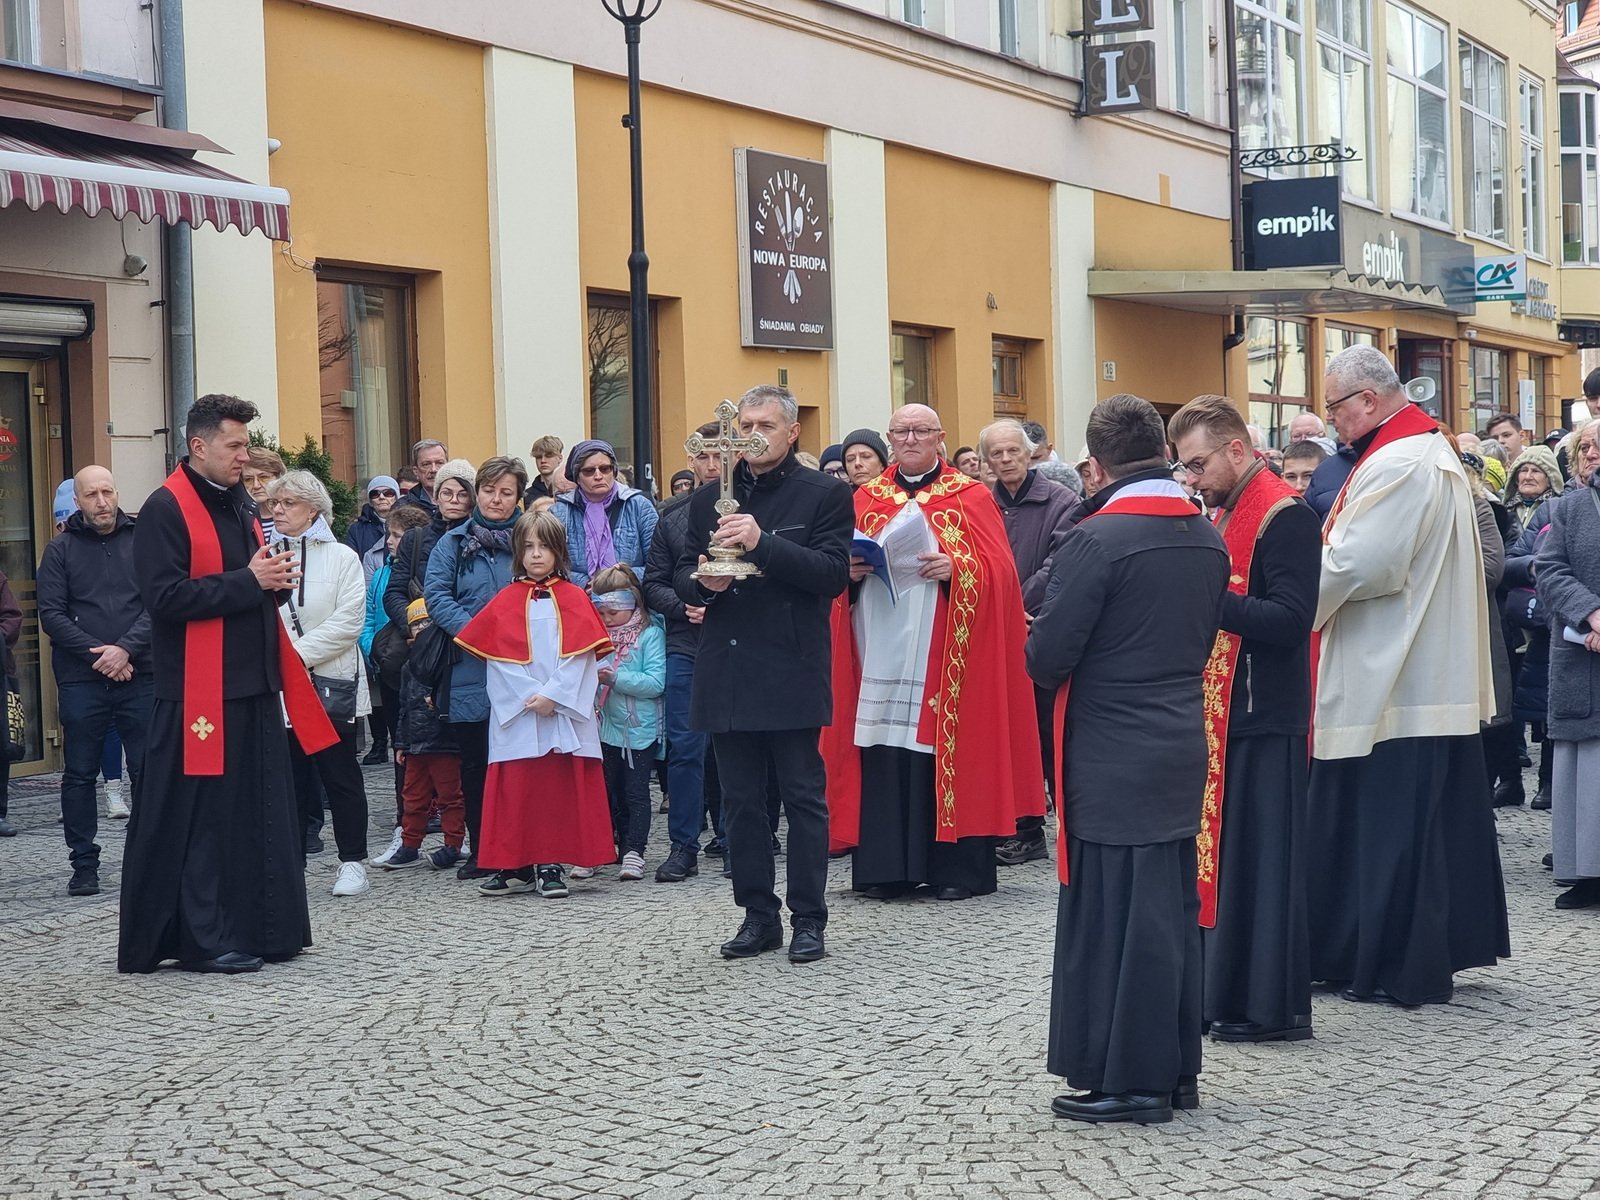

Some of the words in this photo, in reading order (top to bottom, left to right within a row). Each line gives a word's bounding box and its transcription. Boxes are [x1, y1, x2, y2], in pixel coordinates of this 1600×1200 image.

[754, 169, 823, 243] RESTAURACJA
[1257, 206, 1336, 237] empik
[753, 249, 786, 267] NOWA
[789, 254, 827, 272] EUROPA
[1362, 230, 1405, 283] empik
[759, 317, 796, 332] ŚNIADANIA
[799, 322, 825, 335] OBIADY
